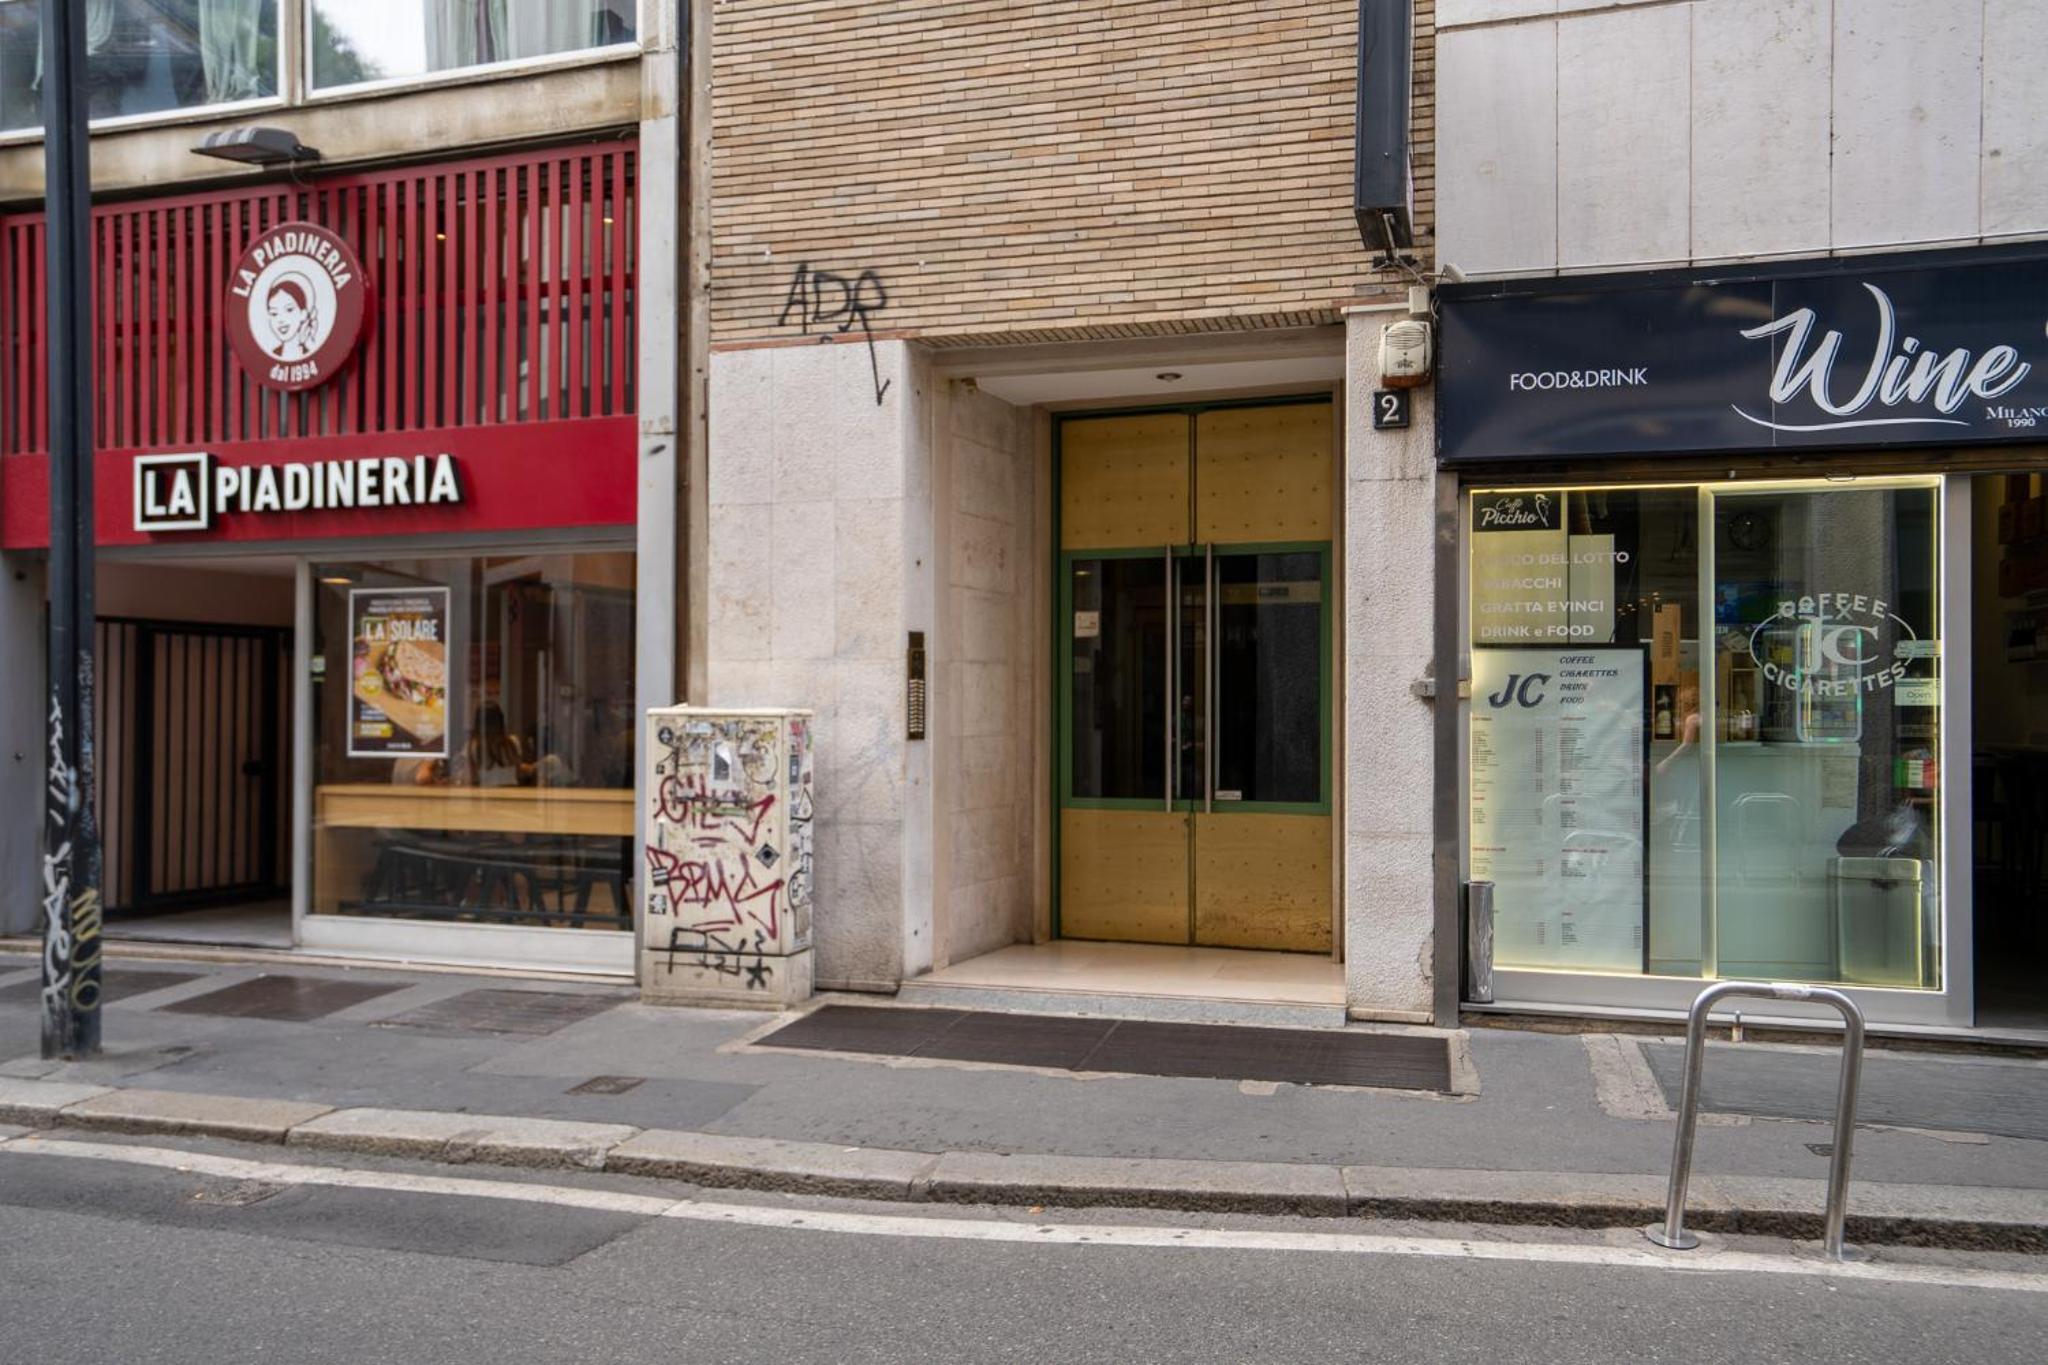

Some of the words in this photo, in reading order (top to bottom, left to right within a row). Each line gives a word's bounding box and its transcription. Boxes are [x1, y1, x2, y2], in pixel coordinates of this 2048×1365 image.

[232, 268, 257, 297] LA
[252, 232, 352, 290] PIADINERIA
[1739, 282, 2031, 415] Wine
[270, 363, 290, 382] dal
[291, 360, 319, 382] 1994
[1510, 367, 1648, 391] FOOD&DRINK
[1381, 395, 1399, 422] 2
[2007, 418, 2036, 428] 1990
[145, 468, 196, 516] LA
[215, 453, 460, 513] PIADINERIA
[1481, 507, 1538, 527] Picchio
[1539, 552, 1569, 565] DEL
[1574, 551, 1630, 565] LOTTO
[1482, 578, 1562, 590] BACCHI
[1480, 602, 1543, 613] GRATTA
[1548, 601, 1557, 612] E
[1559, 600, 1604, 612] VINCI
[365, 622, 385, 640] LA
[390, 618, 438, 641] SOLARE
[1480, 625, 1530, 637] DRINK
[1547, 624, 1595, 637] FOOD
[1560, 656, 1595, 664] COFFEE
[1560, 669, 1618, 678] CIGARETTES
[1763, 662, 1906, 697] CIGARETTES
[1488, 673, 1552, 709] JC
